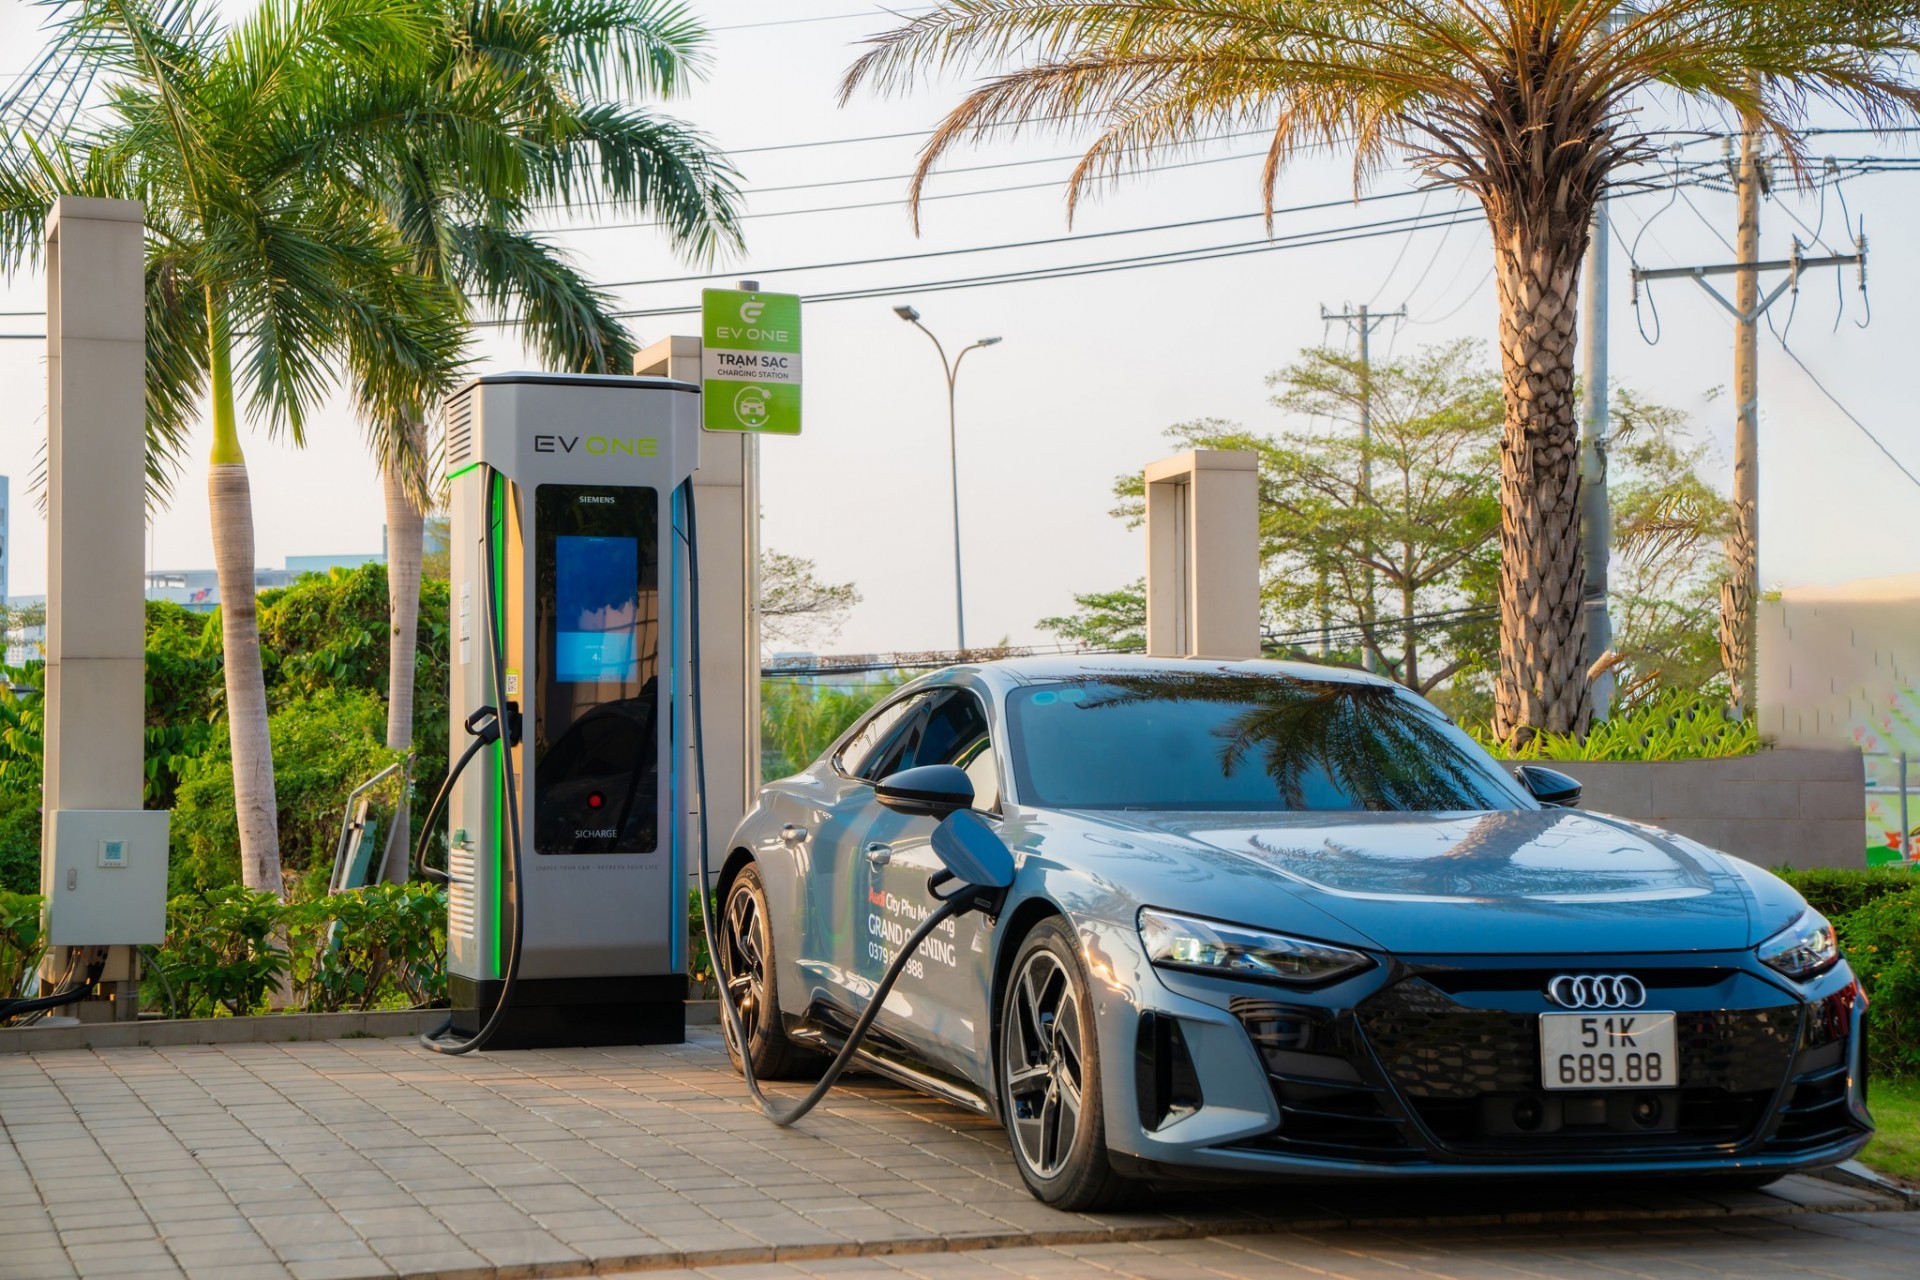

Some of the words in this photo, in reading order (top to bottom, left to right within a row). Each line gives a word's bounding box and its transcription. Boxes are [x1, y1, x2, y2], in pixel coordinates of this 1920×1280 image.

[717, 326, 743, 339] EV
[746, 328, 789, 342] ONE
[717, 368, 757, 378] CHARGING
[758, 371, 789, 379] STATION
[534, 435, 580, 453] EV
[585, 436, 658, 457] ONE
[579, 495, 616, 504] SIEMENS
[575, 829, 618, 839] SICHARGE
[868, 886, 886, 908] Audi
[886, 892, 900, 917] City
[901, 898, 916, 920] Phu
[868, 913, 903, 946] GRAND
[904, 927, 956, 967] OENING
[868, 941, 889, 964] 0379
[906, 958, 924, 979] 988
[1581, 1017, 1637, 1048] 51K
[1559, 1052, 1662, 1084] 689.88
